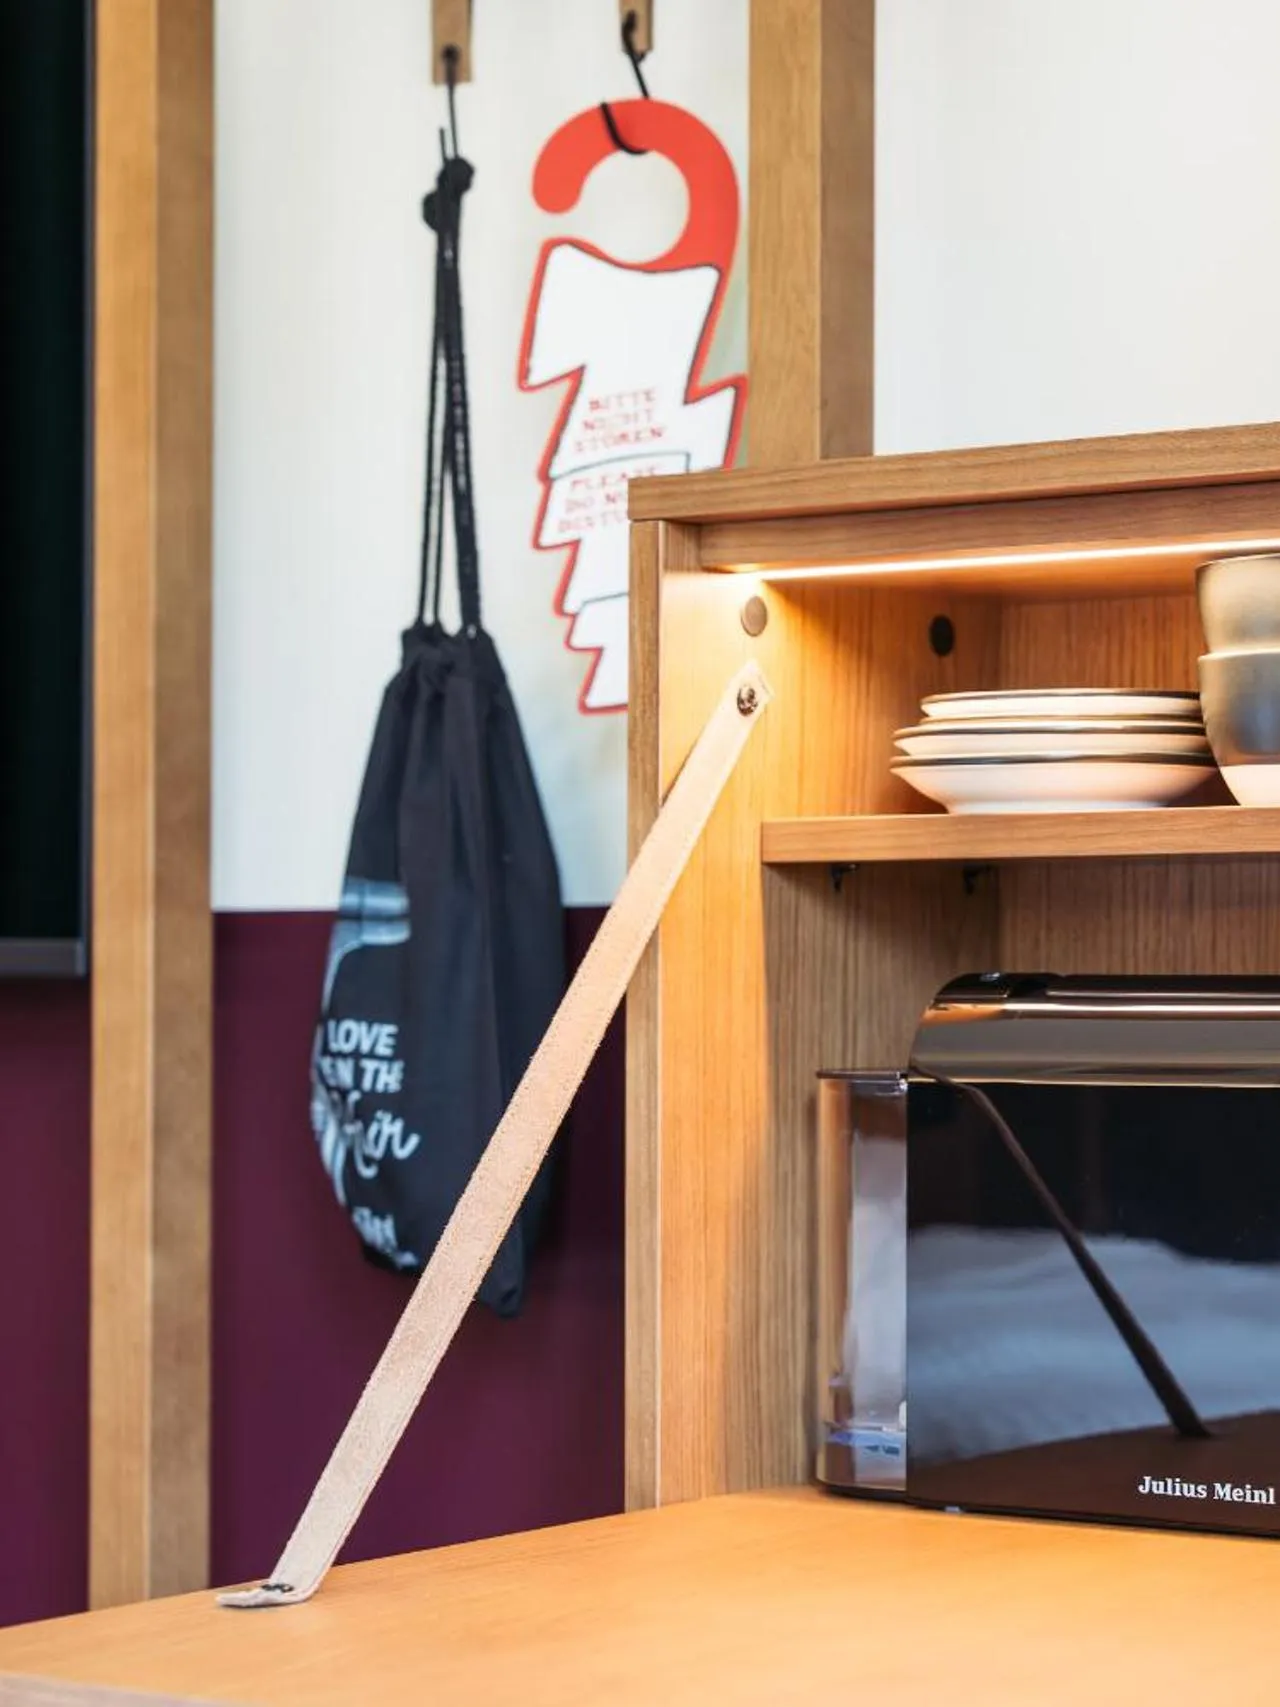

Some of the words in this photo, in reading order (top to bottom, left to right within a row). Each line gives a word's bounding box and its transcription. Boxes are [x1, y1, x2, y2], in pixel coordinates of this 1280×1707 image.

[327, 1019, 399, 1056] LOVE
[1138, 1476, 1207, 1500] Julius
[1213, 1482, 1277, 1505] Meinl
